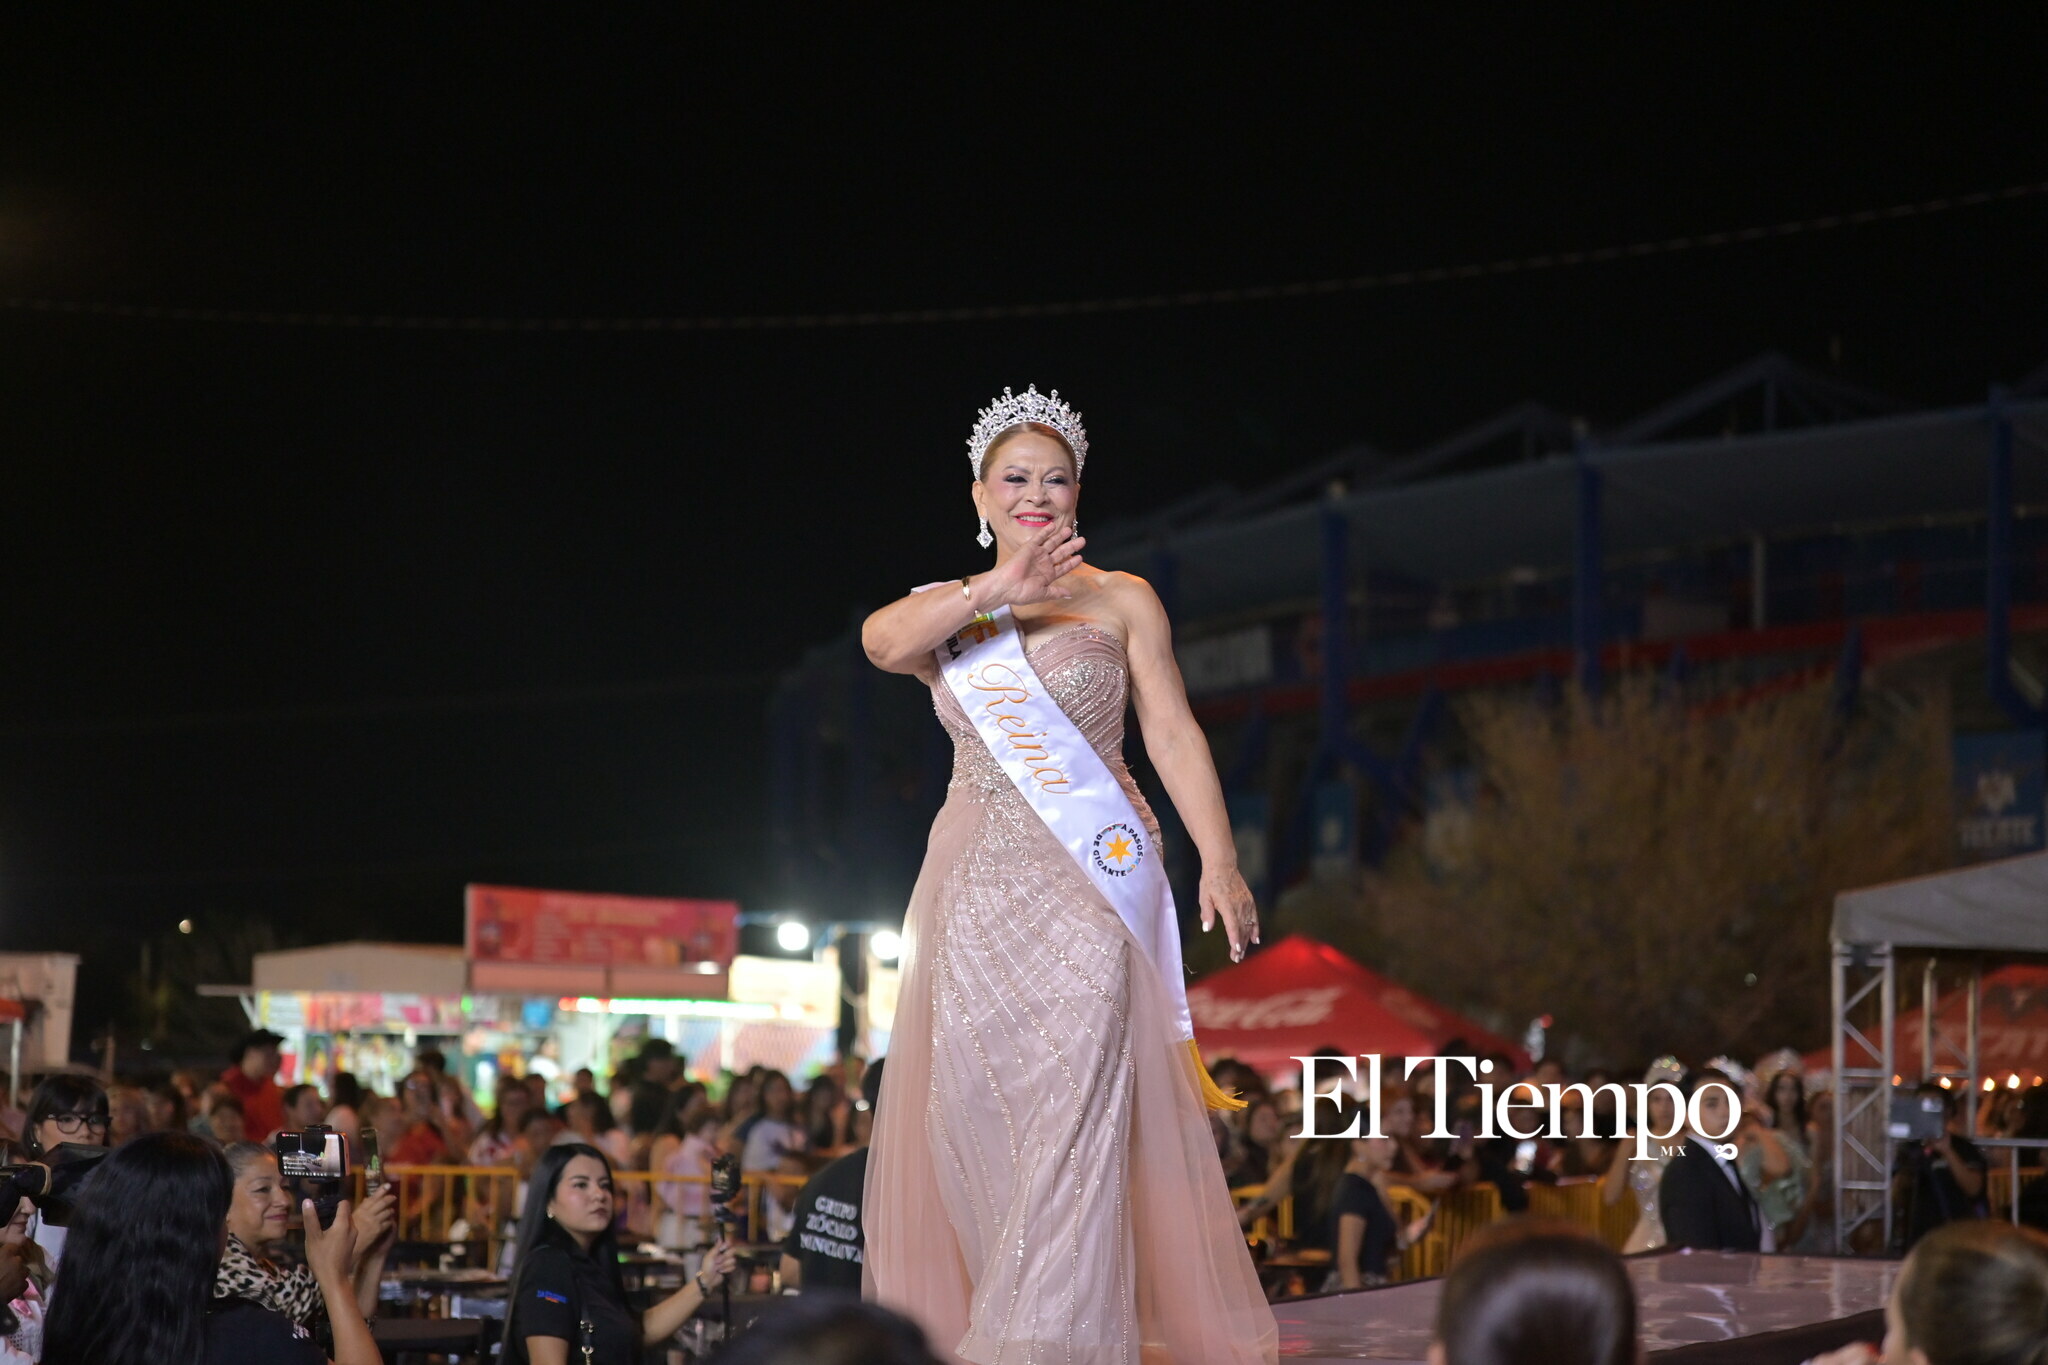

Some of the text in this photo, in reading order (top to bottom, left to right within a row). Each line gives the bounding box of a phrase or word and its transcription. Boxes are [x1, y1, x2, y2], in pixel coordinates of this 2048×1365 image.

[967, 664, 1070, 794] Reina
[1093, 833, 1127, 877] DE GIGANTE
[1128, 828, 1144, 857] PASOS
